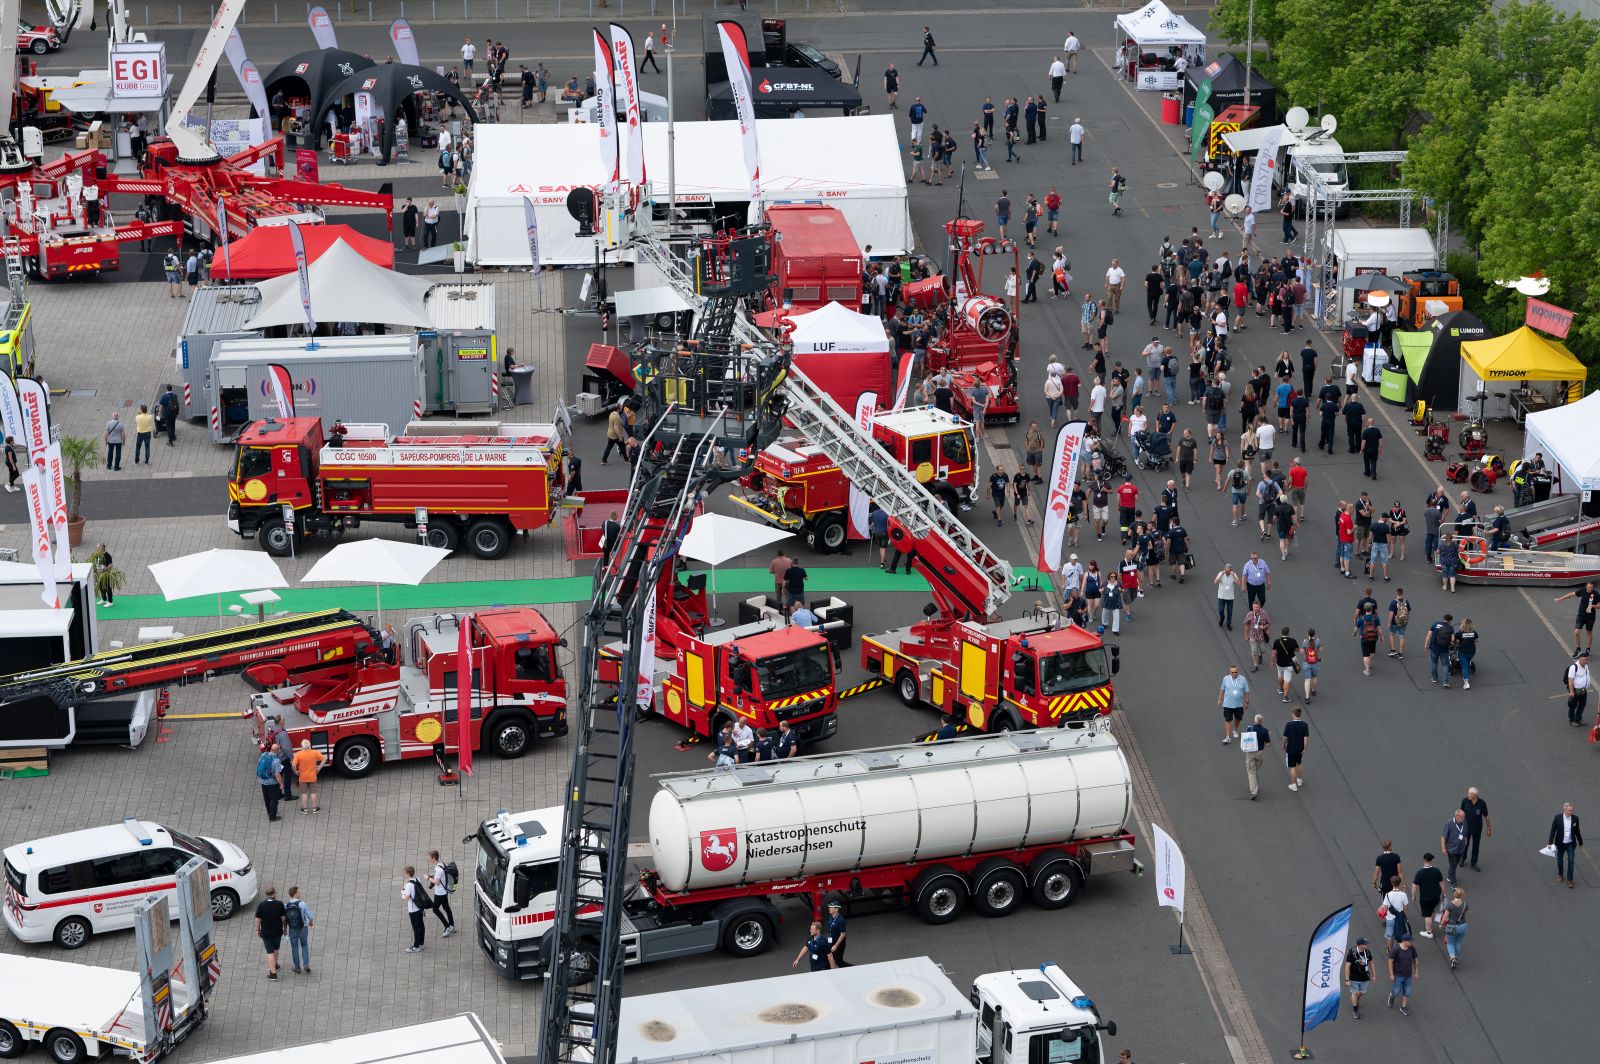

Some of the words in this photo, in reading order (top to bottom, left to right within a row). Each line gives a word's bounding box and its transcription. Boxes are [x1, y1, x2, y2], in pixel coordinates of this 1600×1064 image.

[115, 60, 158, 80] EGI
[116, 82, 138, 90] KLUBB
[140, 82, 159, 90] Group
[922, 284, 933, 292] LUF
[813, 342, 836, 351] LUF
[335, 453, 356, 461] CCGC
[358, 453, 377, 461] 10500
[1058, 434, 1075, 492] DESAUTEL
[333, 708, 365, 720] TELEFON
[368, 706, 380, 714] 112
[746, 820, 867, 845] Katastrophenschutz
[746, 840, 833, 859] Niedersachsen
[1321, 947, 1331, 988] POLYMA
